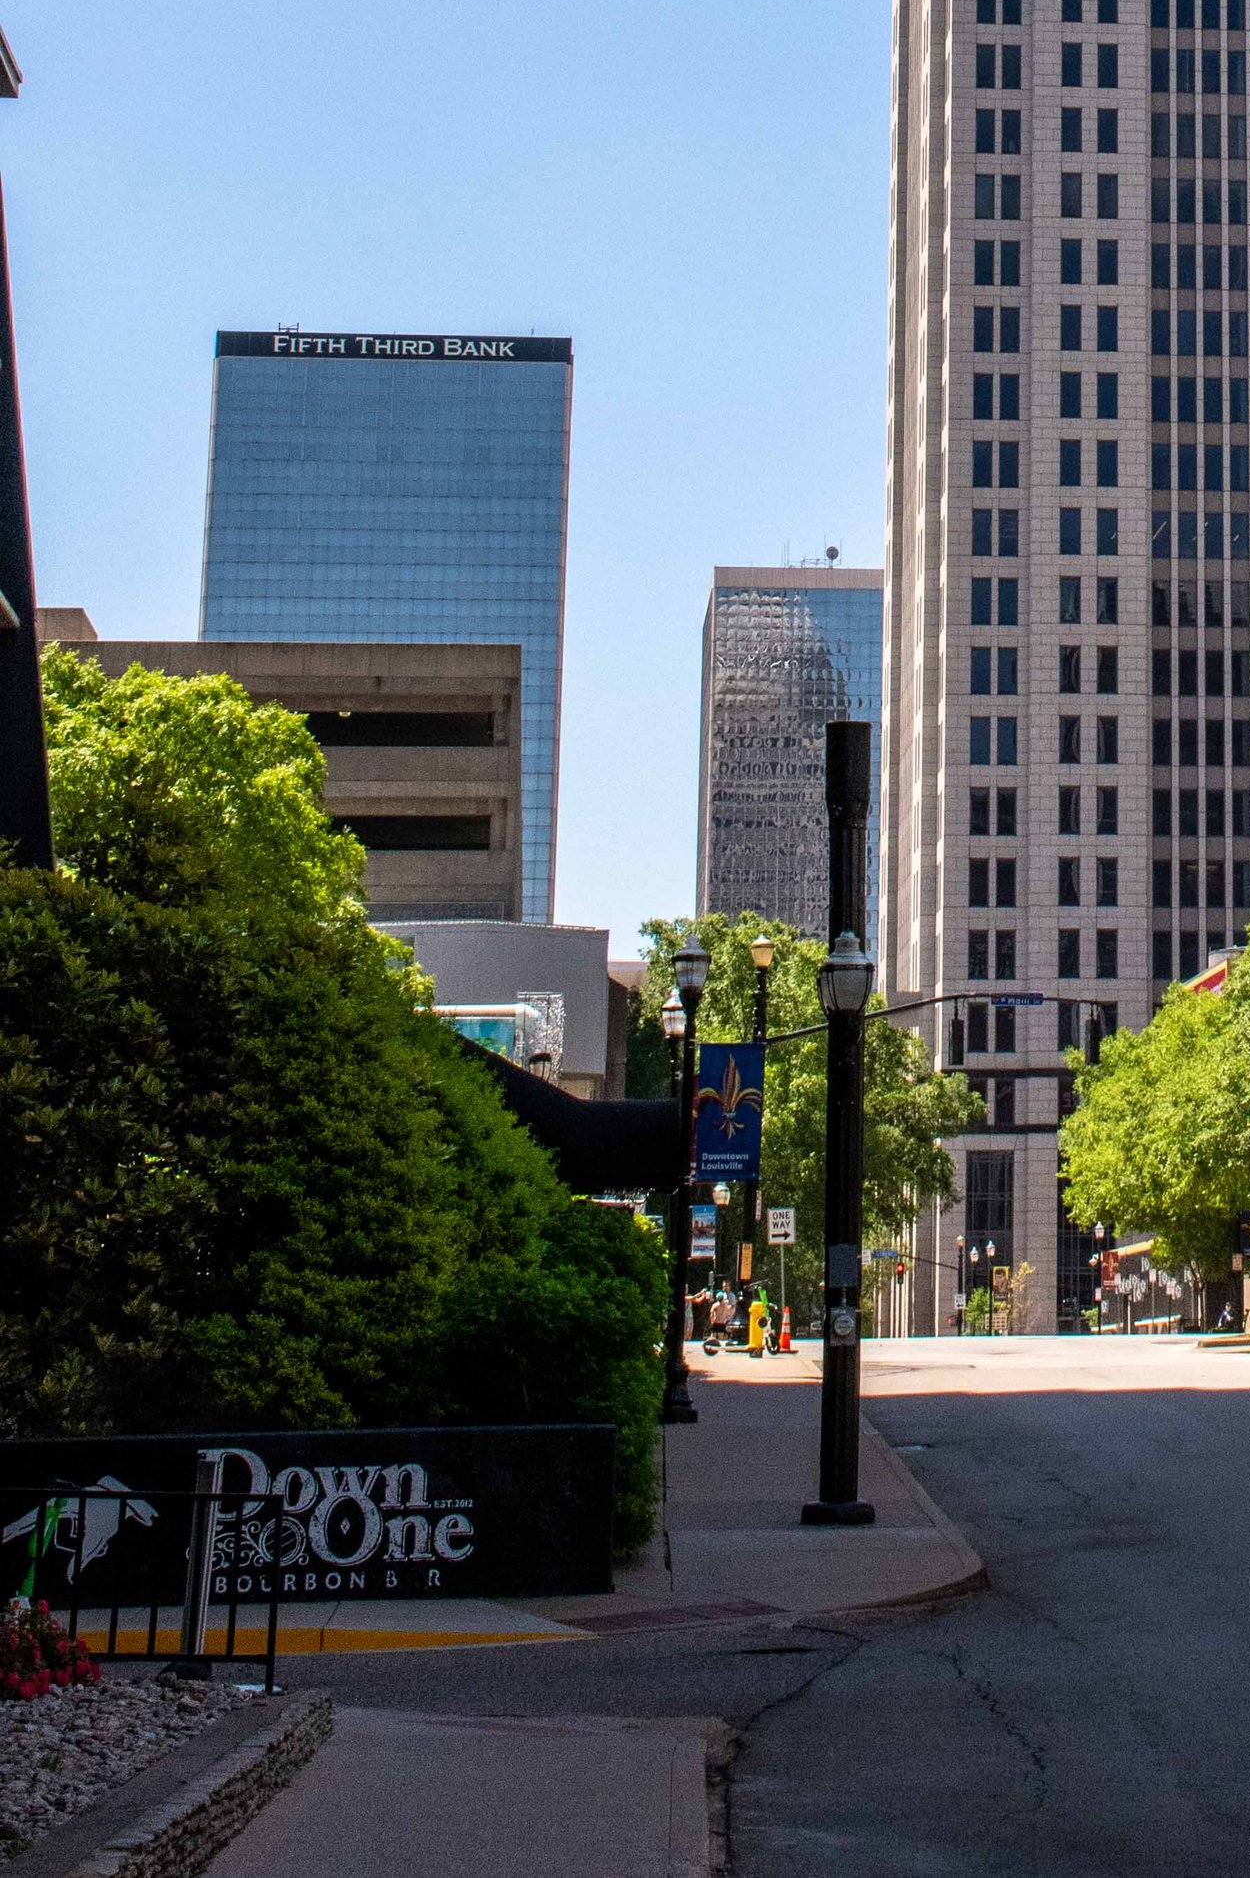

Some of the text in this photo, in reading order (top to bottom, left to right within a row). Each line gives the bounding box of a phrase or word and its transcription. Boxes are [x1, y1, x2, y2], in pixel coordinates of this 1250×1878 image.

[272, 335, 515, 358] FIFTH THIRD BANK
[701, 1153, 749, 1162] Downtown
[701, 1162, 743, 1171] Louisville
[772, 1211, 790, 1220] ONE
[772, 1220, 792, 1229] WAY
[197, 1448, 432, 1520] Down
[308, 1494, 474, 1567] One
[385, 1568, 441, 1589] BR
